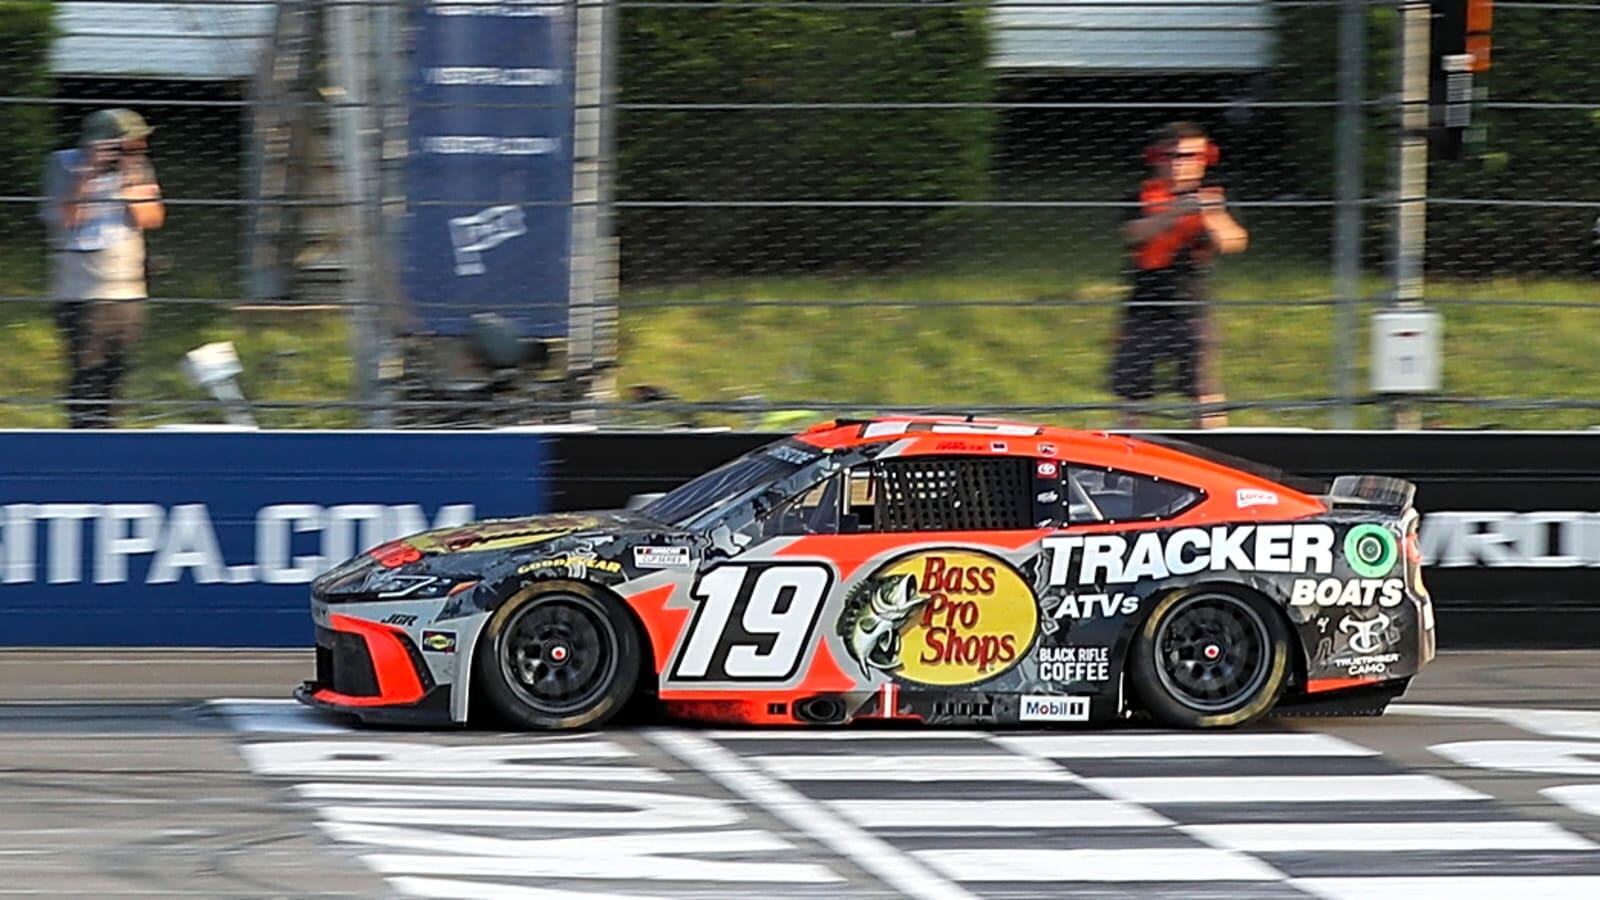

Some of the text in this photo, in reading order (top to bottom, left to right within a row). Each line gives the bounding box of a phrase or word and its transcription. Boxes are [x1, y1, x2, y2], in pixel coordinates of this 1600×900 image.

[0, 502, 476, 584] ITPA.COM
[1042, 523, 1335, 587] TRACKER
[919, 556, 997, 593] Bass
[1054, 593, 1140, 620] ATVs
[1290, 578, 1405, 607] BOATS
[674, 563, 832, 680] 19
[921, 592, 980, 629] Pro
[920, 627, 1017, 673] Shops
[1039, 647, 1109, 662] BLACK RIFLE
[1040, 662, 1110, 681] COFFEE
[1348, 662, 1386, 675] CAMO
[1026, 702, 1067, 715] Mobil
